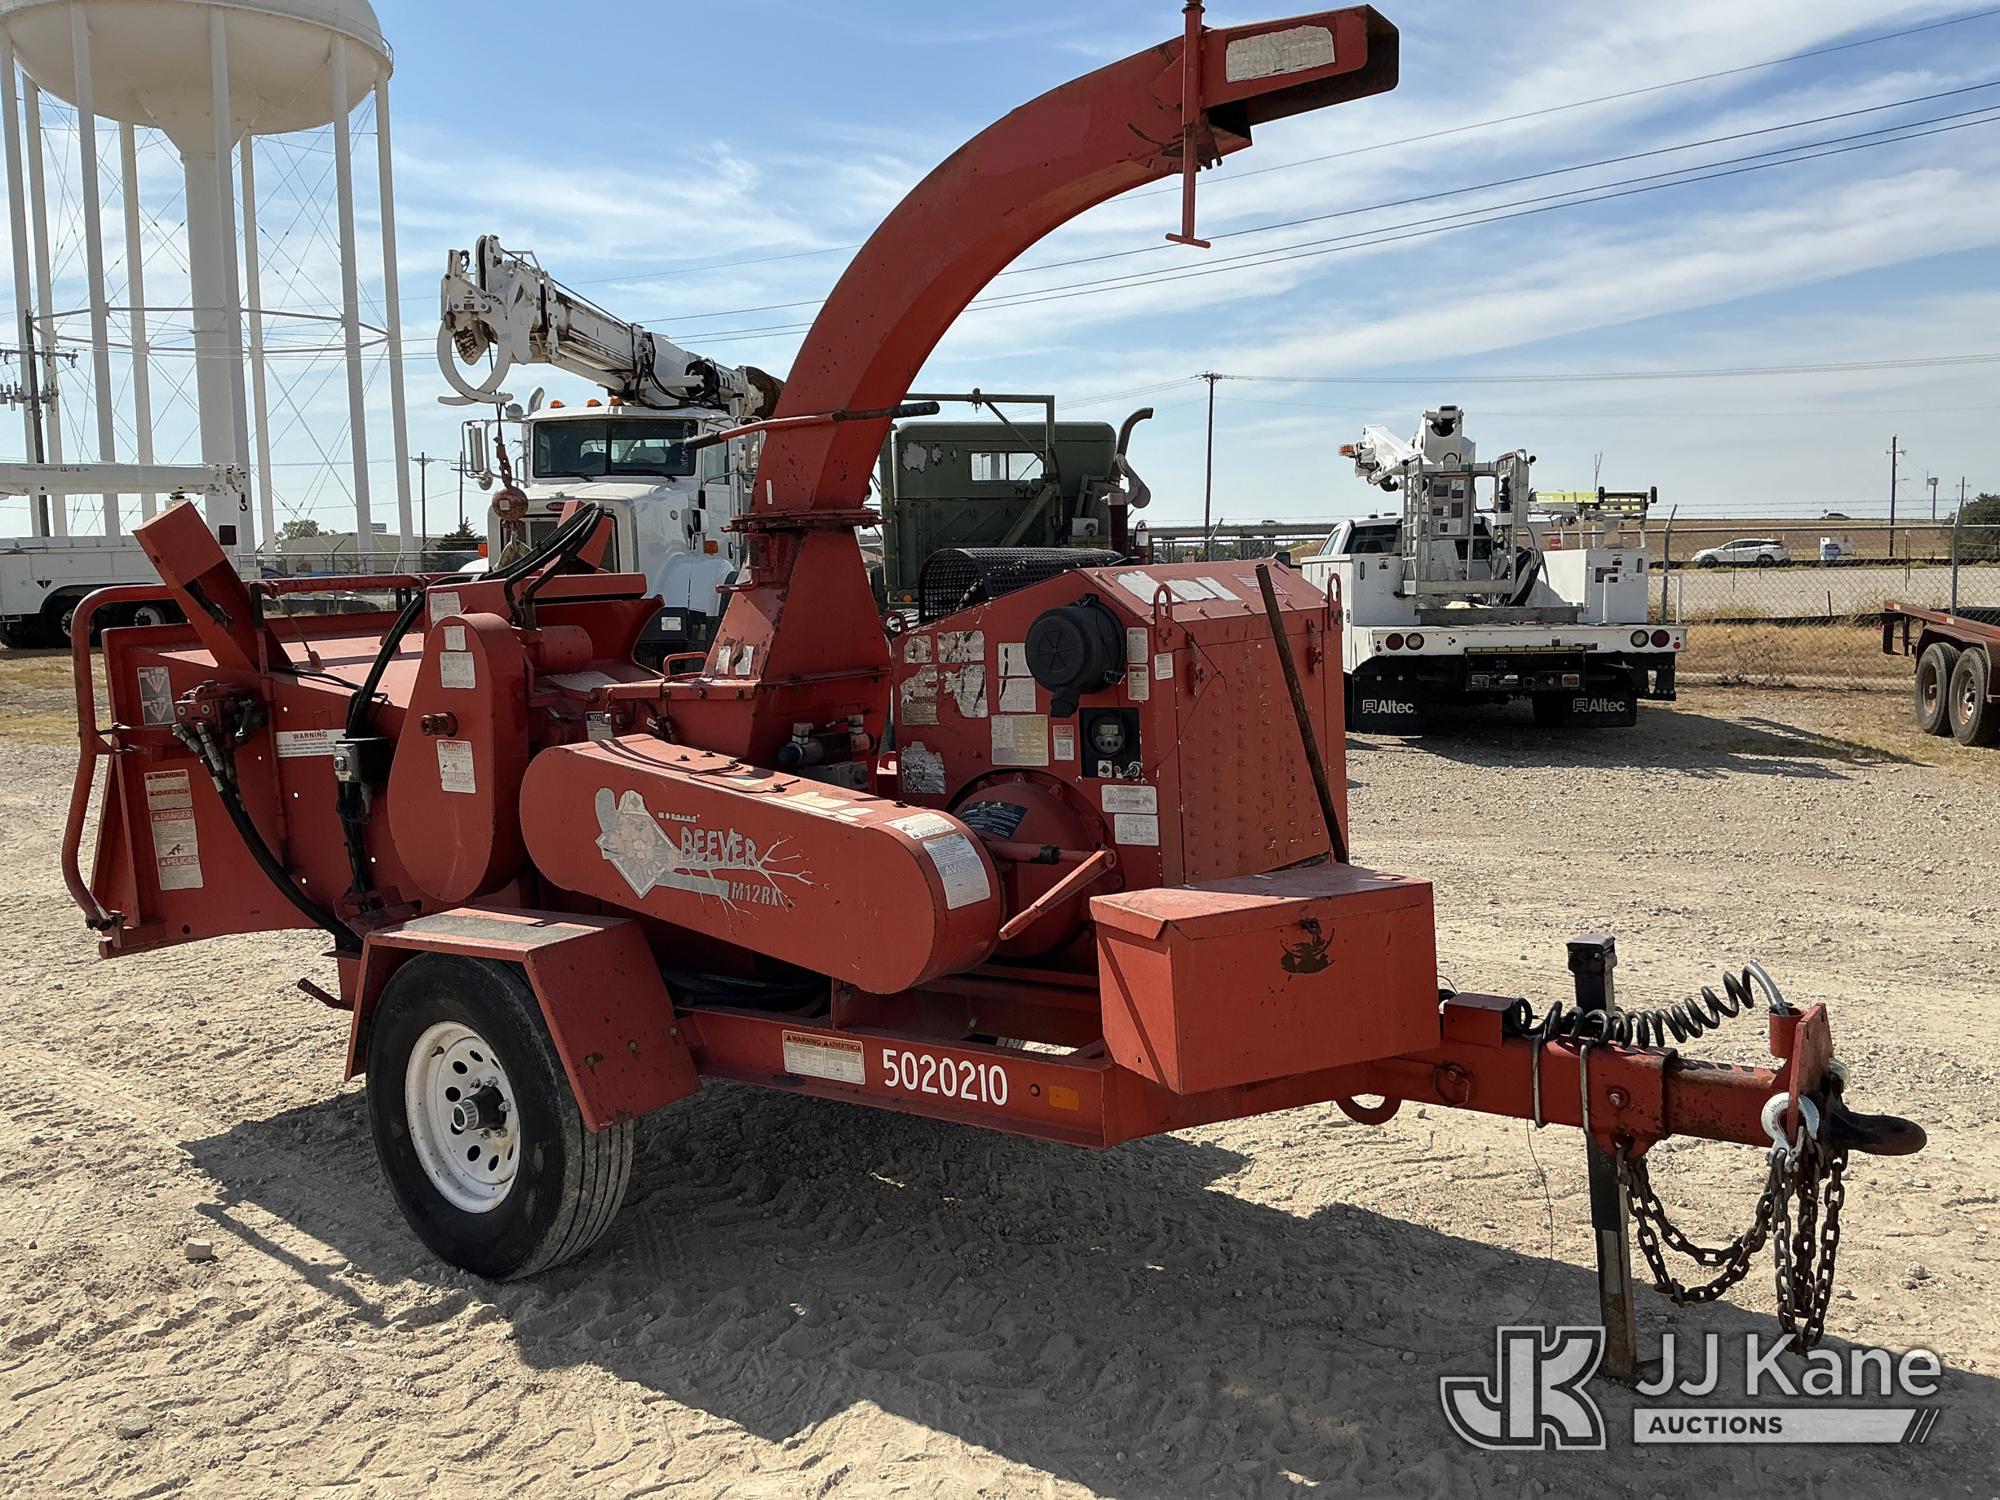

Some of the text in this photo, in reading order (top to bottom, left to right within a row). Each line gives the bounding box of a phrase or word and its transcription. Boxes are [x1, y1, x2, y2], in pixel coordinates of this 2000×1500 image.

[1377, 699, 1414, 713] Altec
[1589, 697, 1625, 712] Altec
[293, 731, 328, 740] WARNING
[154, 771, 186, 779] WARNING
[160, 810, 193, 820] DANGER
[681, 825, 758, 870] BEEVER
[166, 856, 198, 866] PELIGRO
[731, 881, 778, 906] M12RX
[792, 1035, 822, 1046] WARNING
[882, 1048, 1008, 1106] 5020210
